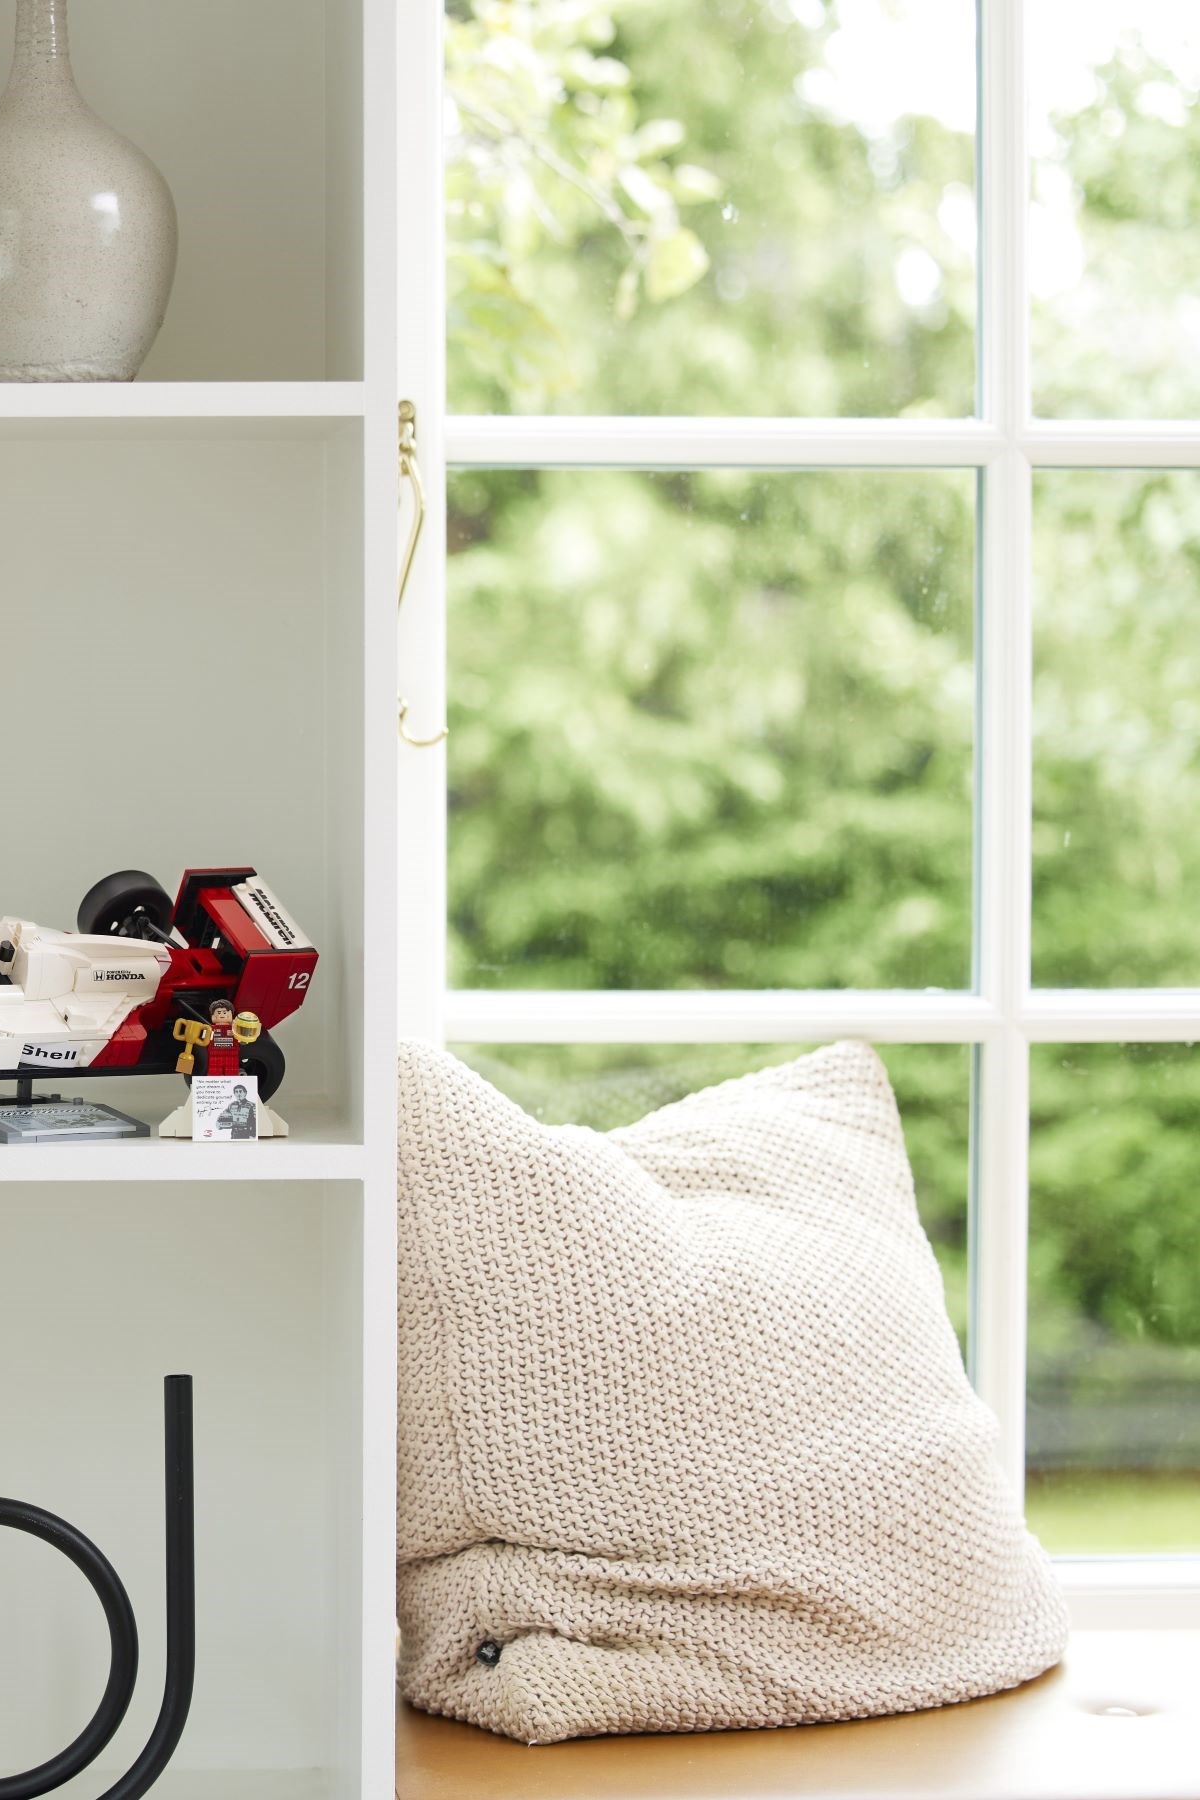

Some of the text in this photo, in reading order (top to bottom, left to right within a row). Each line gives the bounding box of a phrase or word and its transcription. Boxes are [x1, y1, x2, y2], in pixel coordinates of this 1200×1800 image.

[106, 973, 146, 981] HONDA
[288, 972, 310, 989] 12
[21, 1044, 77, 1060] Shell
